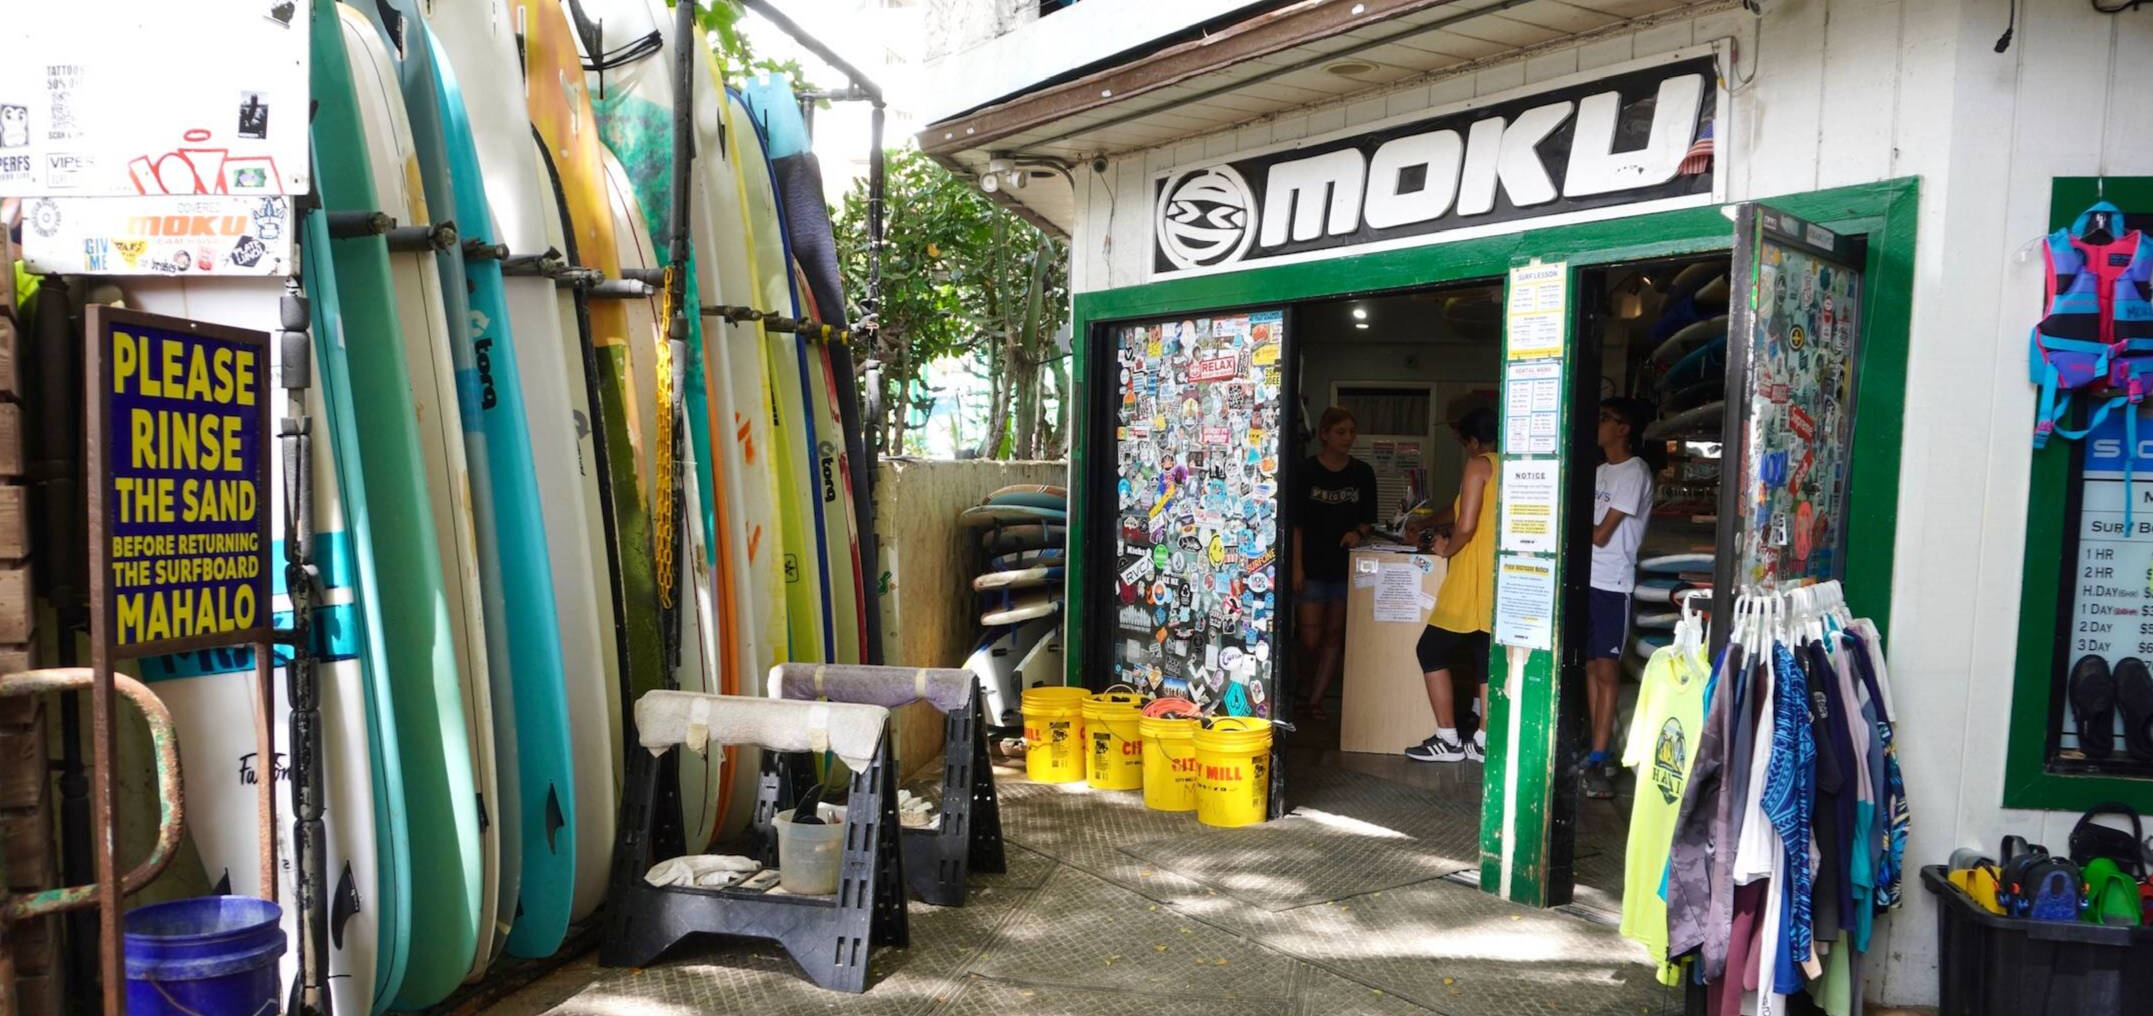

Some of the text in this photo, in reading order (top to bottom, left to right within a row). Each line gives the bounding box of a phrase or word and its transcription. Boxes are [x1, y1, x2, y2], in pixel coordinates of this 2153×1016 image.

[1259, 73, 1706, 249] MOKU
[126, 215, 248, 237] MOKU
[112, 331, 256, 407] PLEASE
[1202, 360, 1233, 372] RELAX
[131, 408, 243, 473] RINSE
[1515, 472, 1546, 480] NOTICE
[114, 477, 257, 524] THE SAND
[112, 532, 259, 558] BEFORE RETURNING
[2096, 549, 2114, 560] HR
[112, 554, 259, 587] THE SURFBOARD
[2084, 566, 2114, 578] 2 HR
[117, 583, 256, 646] MAHALO
[2079, 621, 2088, 632] 2
[2090, 621, 2113, 633] DAY
[2078, 639, 2086, 651] 3
[2088, 639, 2112, 652] DAY
[1122, 740, 1143, 756] CIT
[1171, 758, 1243, 781] CIT MILL
